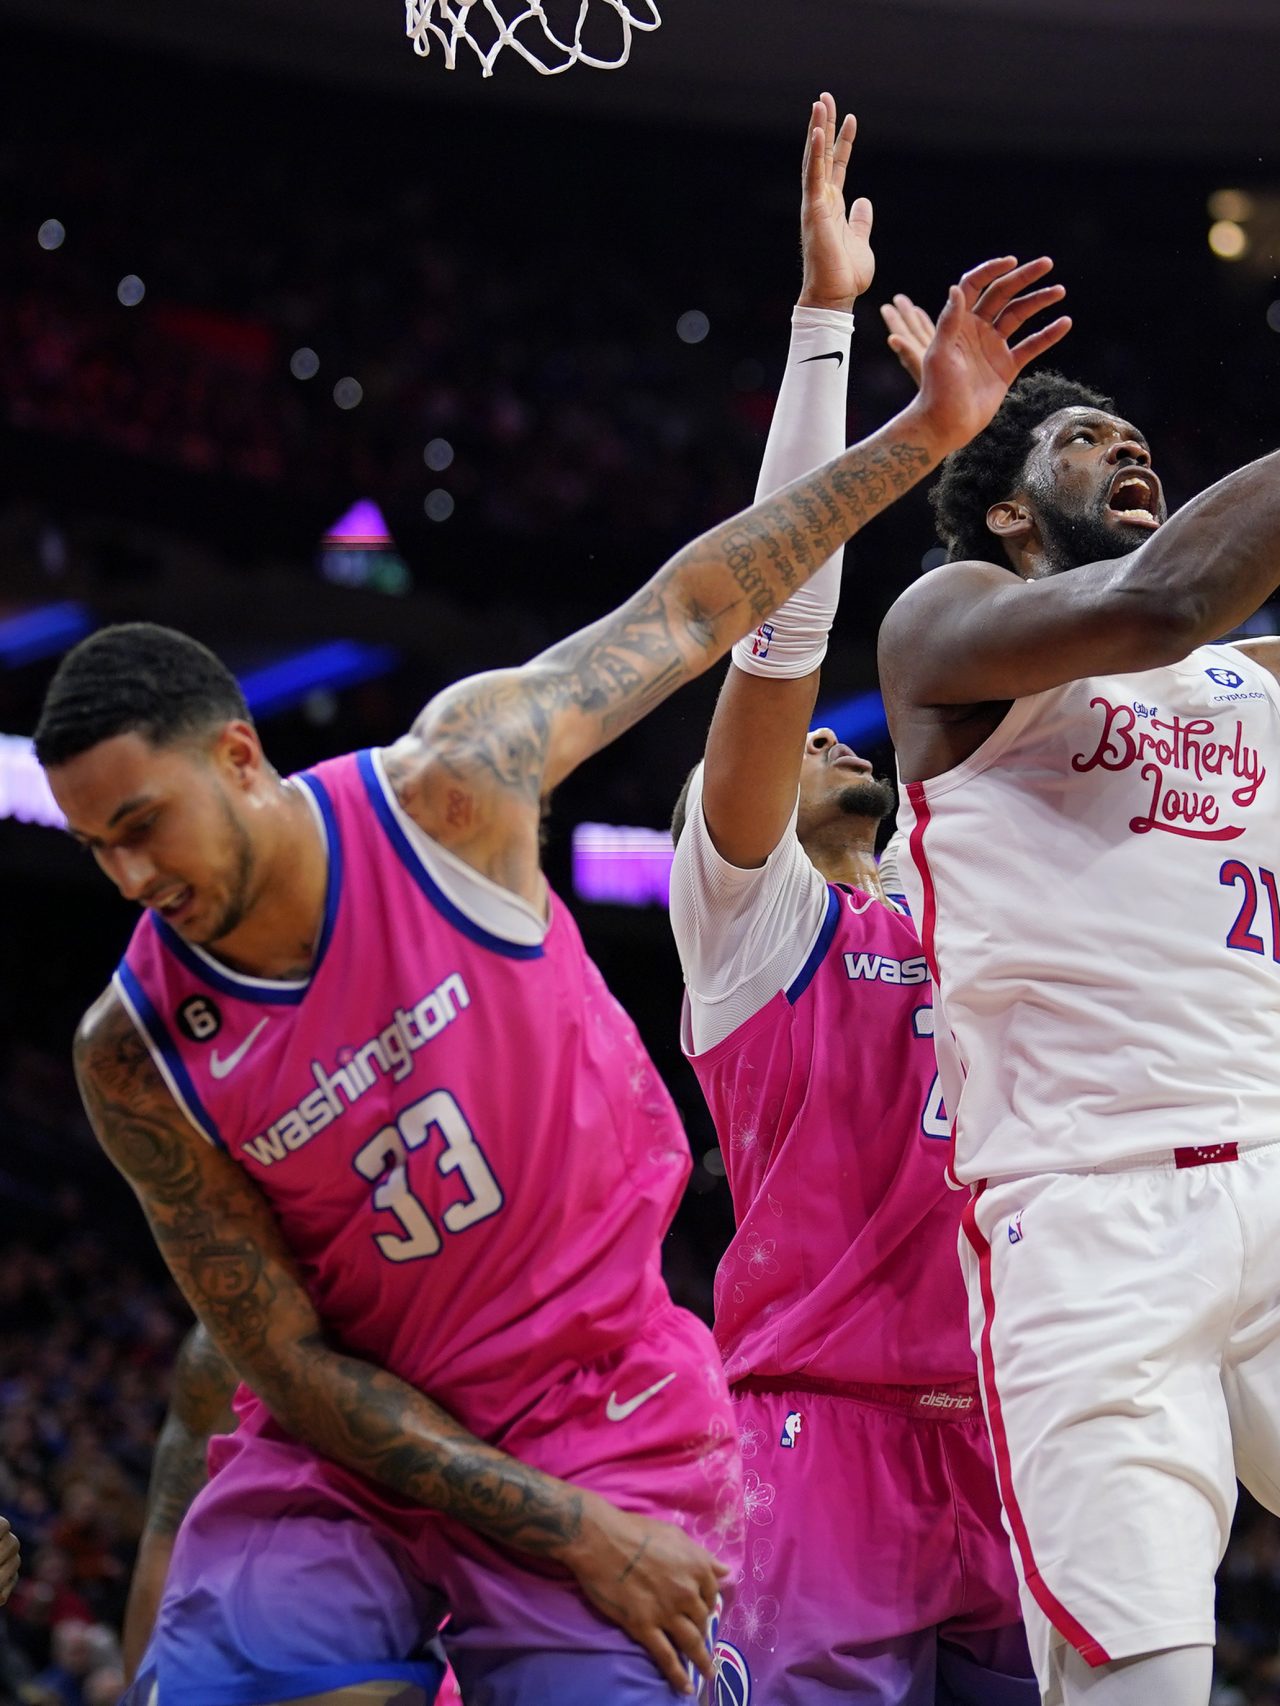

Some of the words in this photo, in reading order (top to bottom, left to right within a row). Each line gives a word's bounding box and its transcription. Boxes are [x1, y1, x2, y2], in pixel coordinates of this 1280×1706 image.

[1071, 697, 1266, 807] Brotherly
[1129, 763, 1247, 841] Love
[843, 952, 933, 986] was
[184, 1000, 217, 1038] 6
[242, 972, 470, 1167] washington
[352, 1088, 503, 1262] 33
[920, 1389, 973, 1409] district
